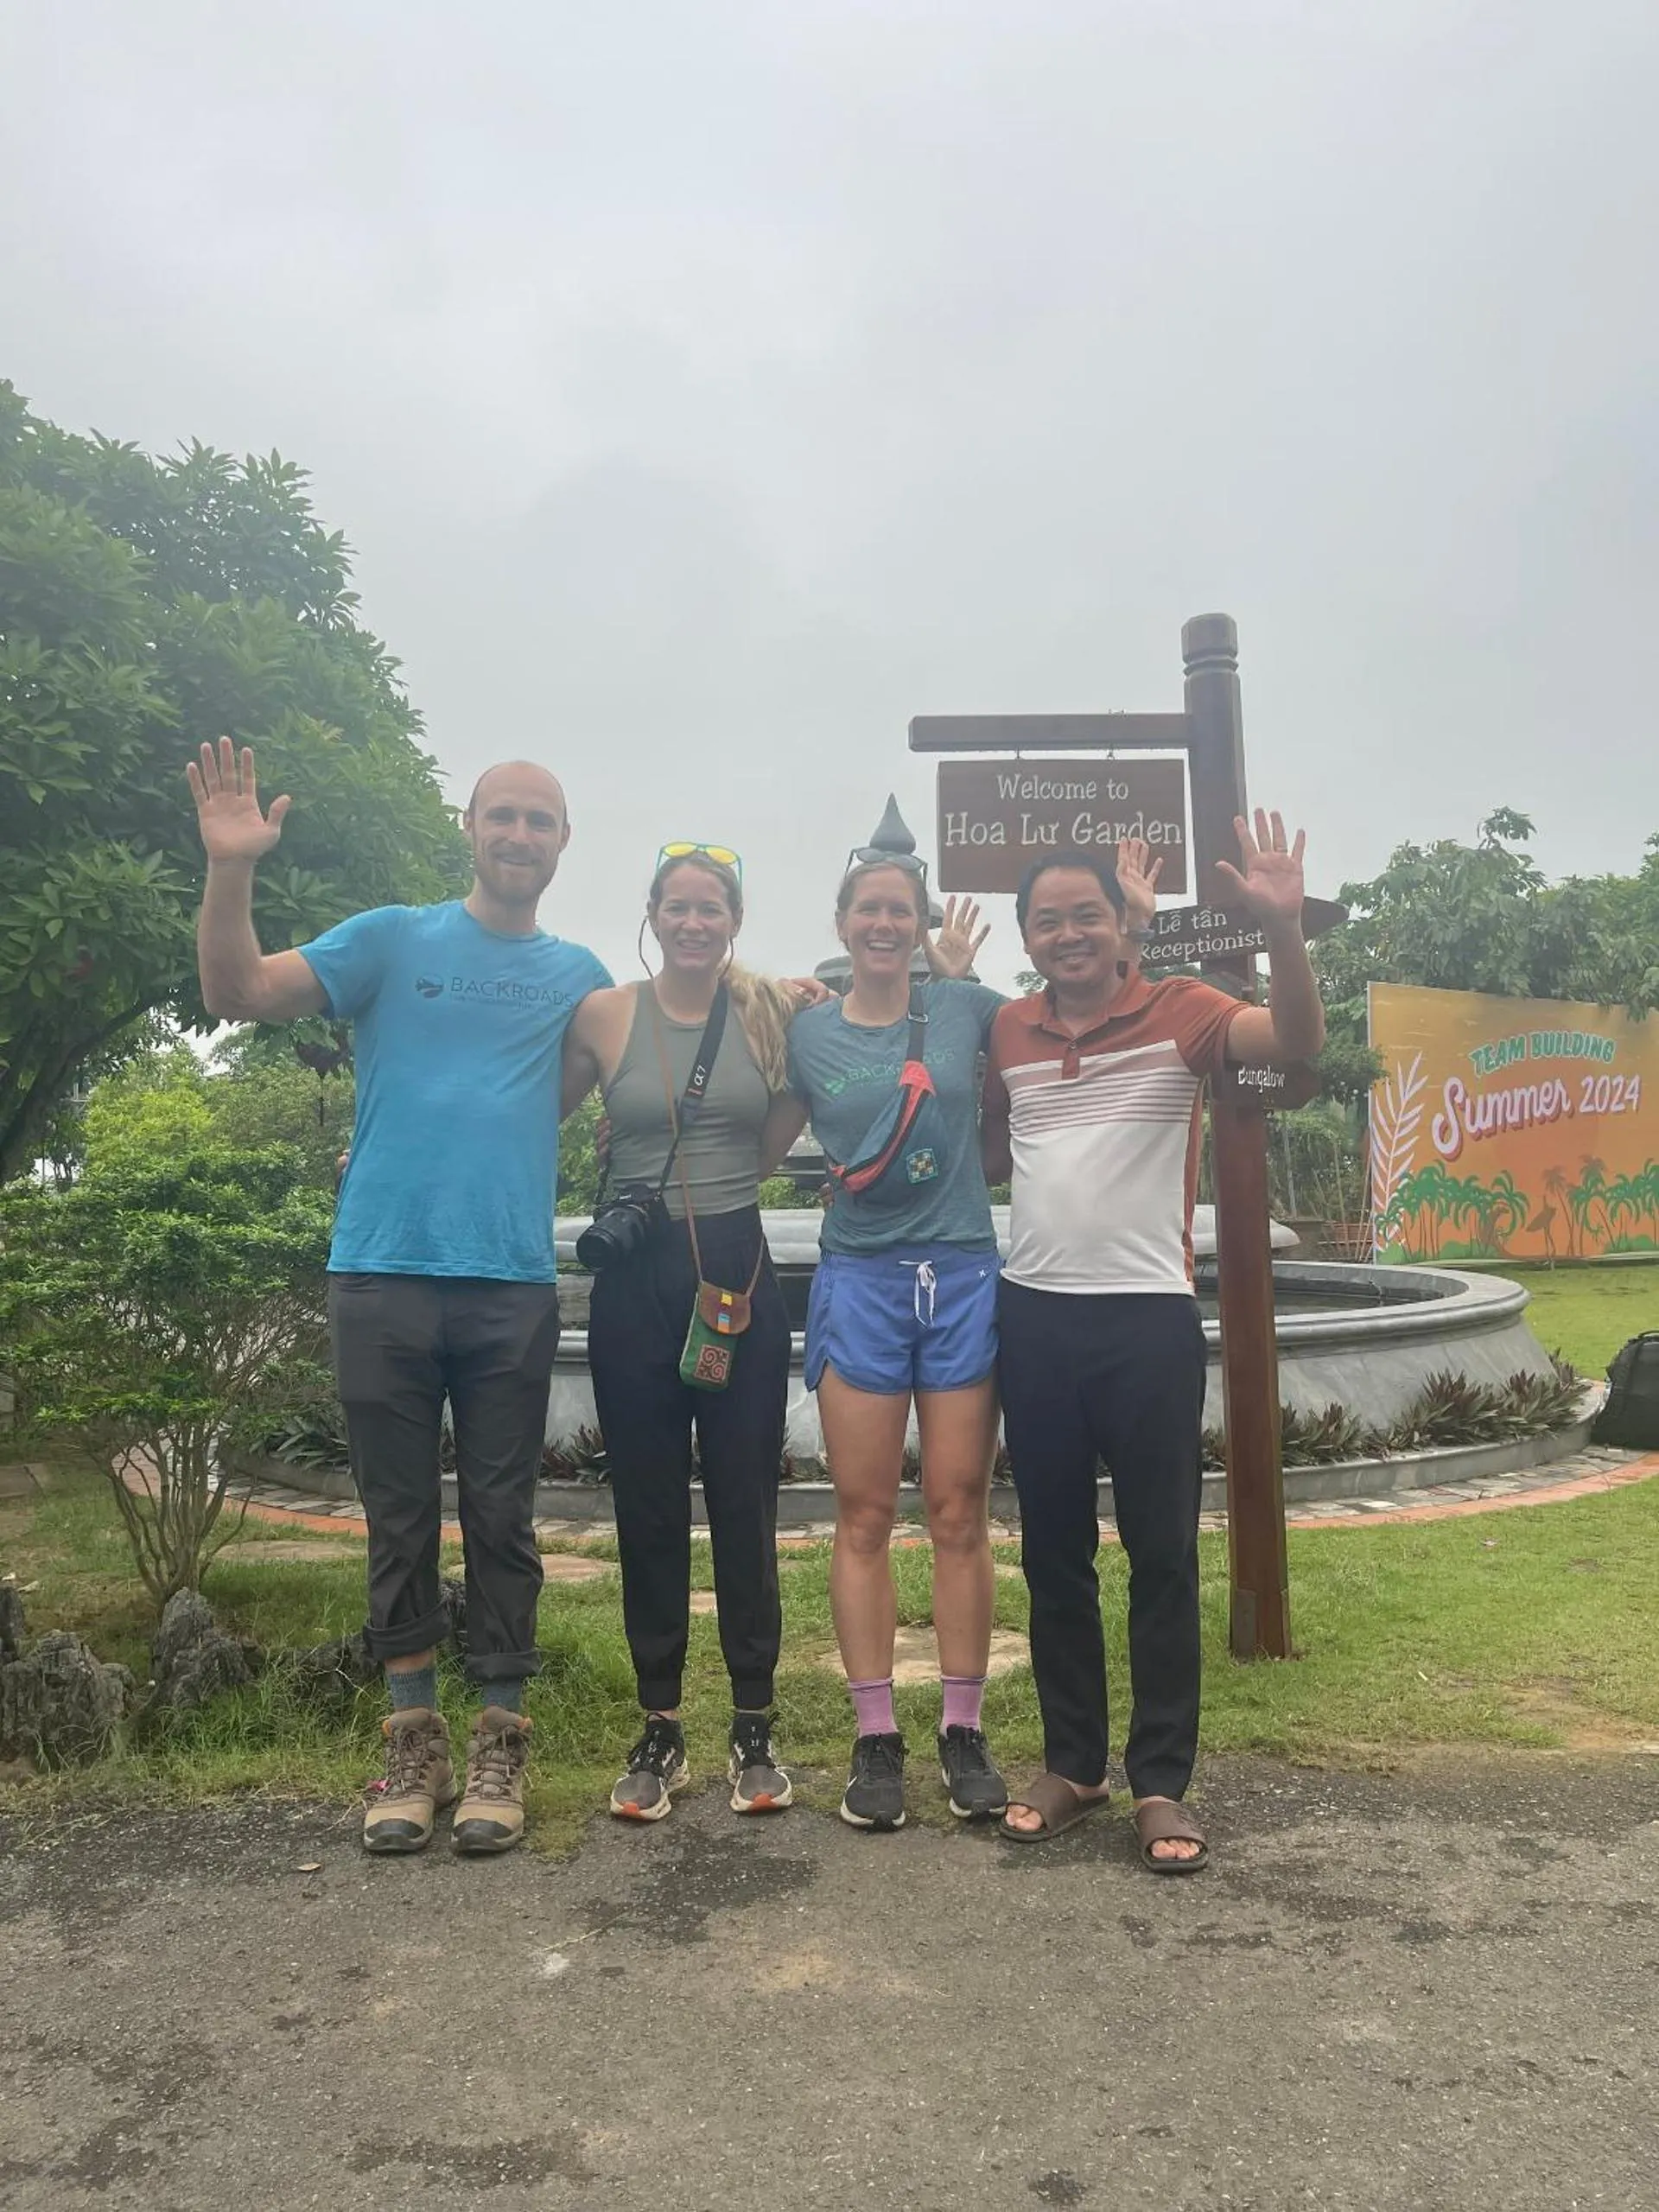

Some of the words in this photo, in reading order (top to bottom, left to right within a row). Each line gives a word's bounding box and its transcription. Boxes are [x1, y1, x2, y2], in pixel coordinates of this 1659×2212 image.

[997, 773, 1097, 800] Welcome
[1107, 778, 1128, 800] to
[945, 811, 1006, 846] Hoa
[1020, 813, 1059, 845] Lư
[1071, 810, 1183, 845] Garden
[1156, 910, 1182, 934] Lễ
[1191, 908, 1227, 930] tân
[450, 976, 574, 1007] BACKROADS
[1469, 1034, 1526, 1077] TEAM
[1529, 1030, 1617, 1065] BUILDING
[1431, 1077, 1571, 1156] Summer
[1579, 1074, 1640, 1114] 2024
